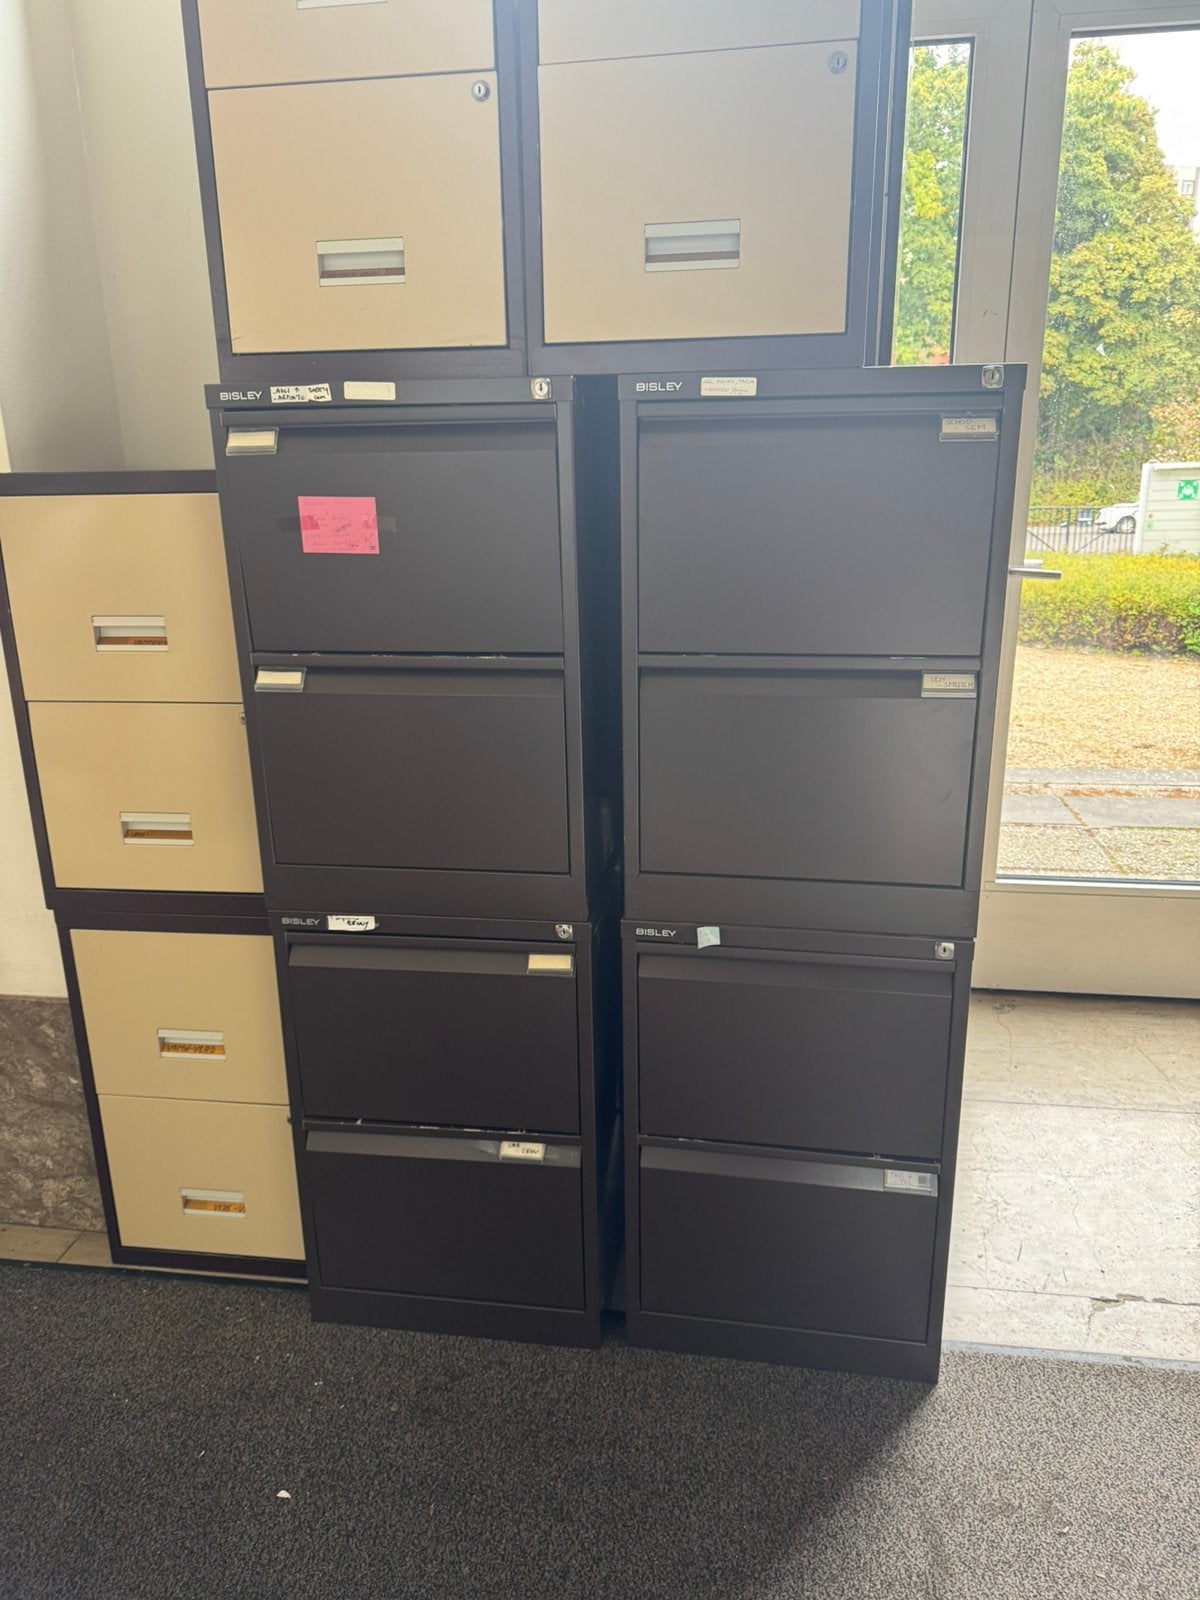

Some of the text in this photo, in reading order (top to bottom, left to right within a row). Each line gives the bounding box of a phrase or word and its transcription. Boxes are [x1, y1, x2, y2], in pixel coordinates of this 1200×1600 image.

[636, 382, 683, 391] BISLEY
[220, 391, 262, 400] BISLEY
[281, 917, 320, 925] BISLEY
[636, 928, 676, 937] BISLEY
